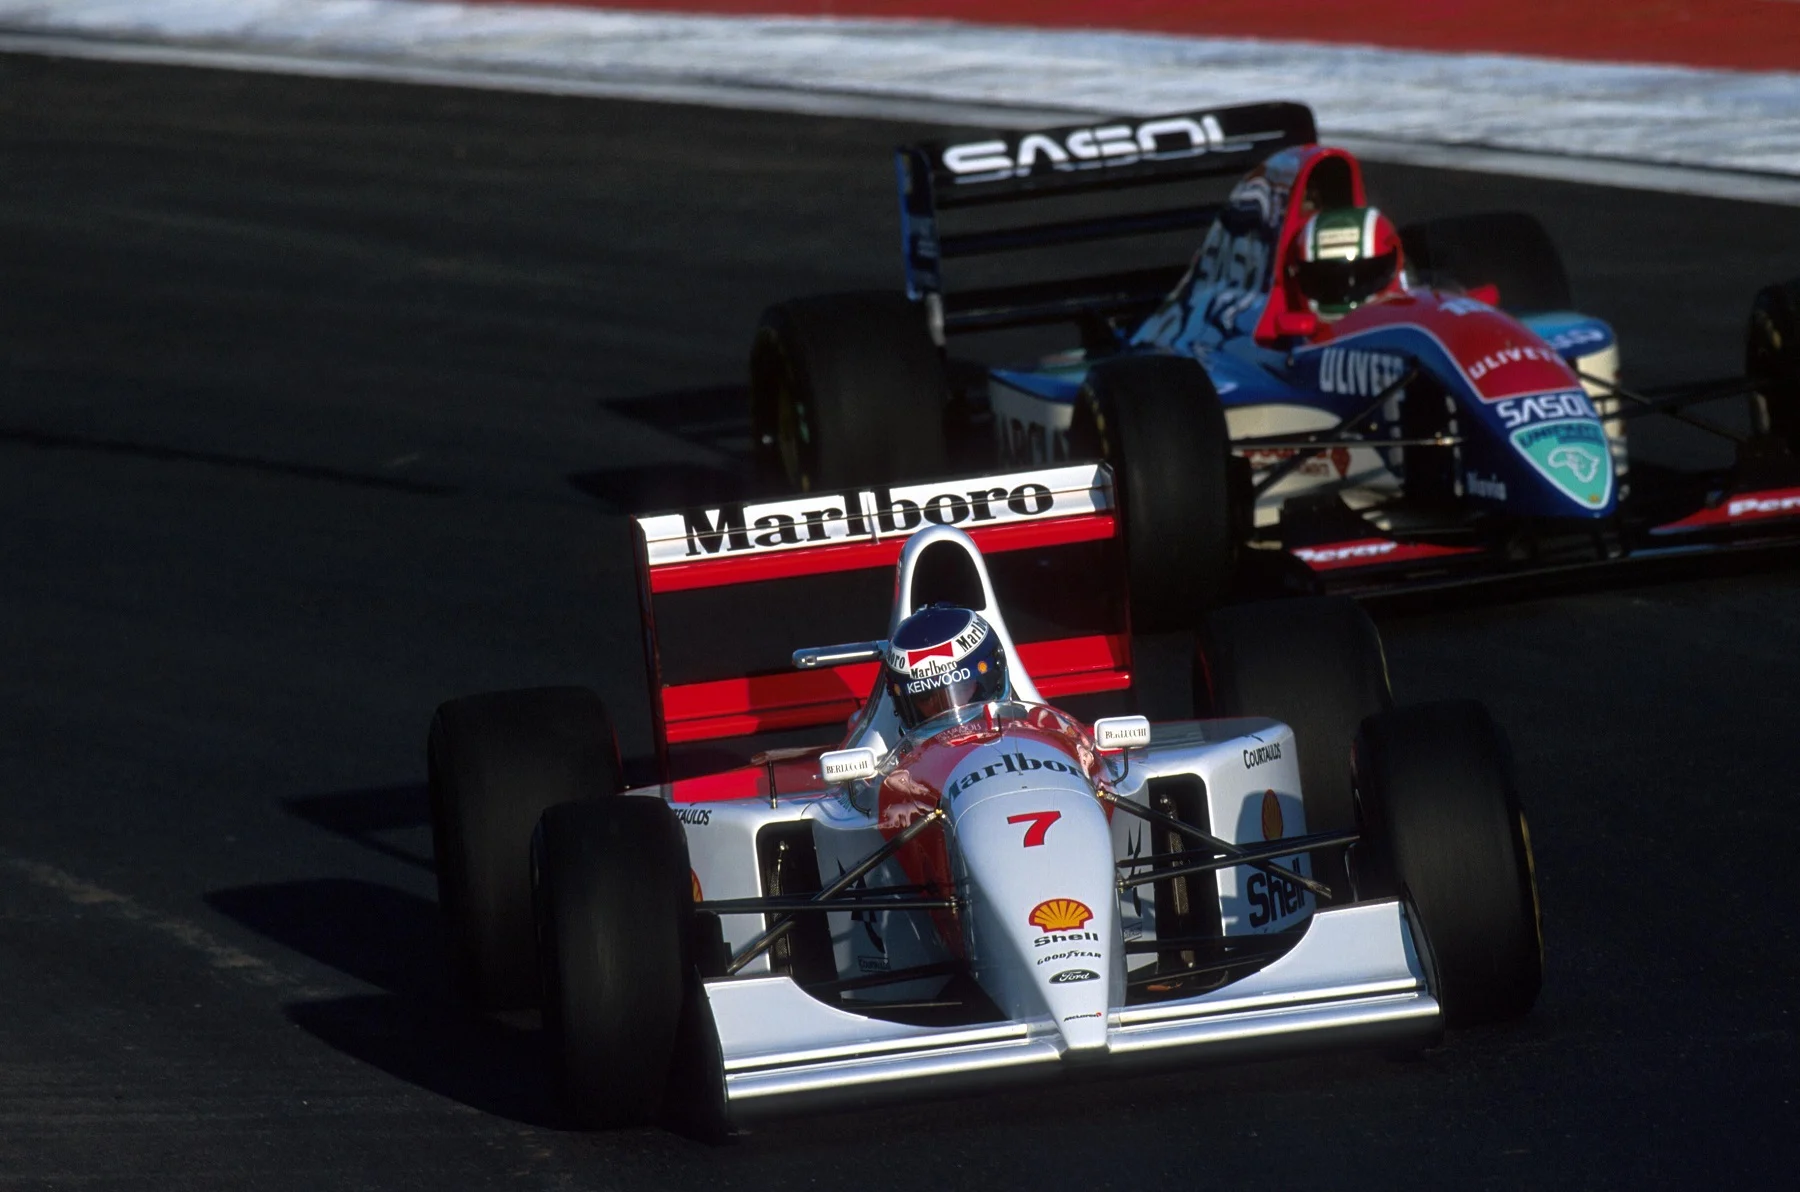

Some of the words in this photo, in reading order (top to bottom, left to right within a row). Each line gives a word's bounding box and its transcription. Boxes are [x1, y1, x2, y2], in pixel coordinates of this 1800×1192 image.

[943, 113, 1284, 178] SASOL
[1496, 393, 1598, 428] SASOL
[684, 482, 1055, 557] Marlboro
[907, 667, 971, 695] KENWOOD
[910, 659, 958, 679] Marlboro
[674, 808, 712, 826] TAULDS
[1007, 810, 1062, 848] 7
[1246, 857, 1306, 929] Shell
[1033, 932, 1099, 947] Shell
[1037, 950, 1102, 965] GOODYEAR
[1059, 971, 1090, 982] Ford
